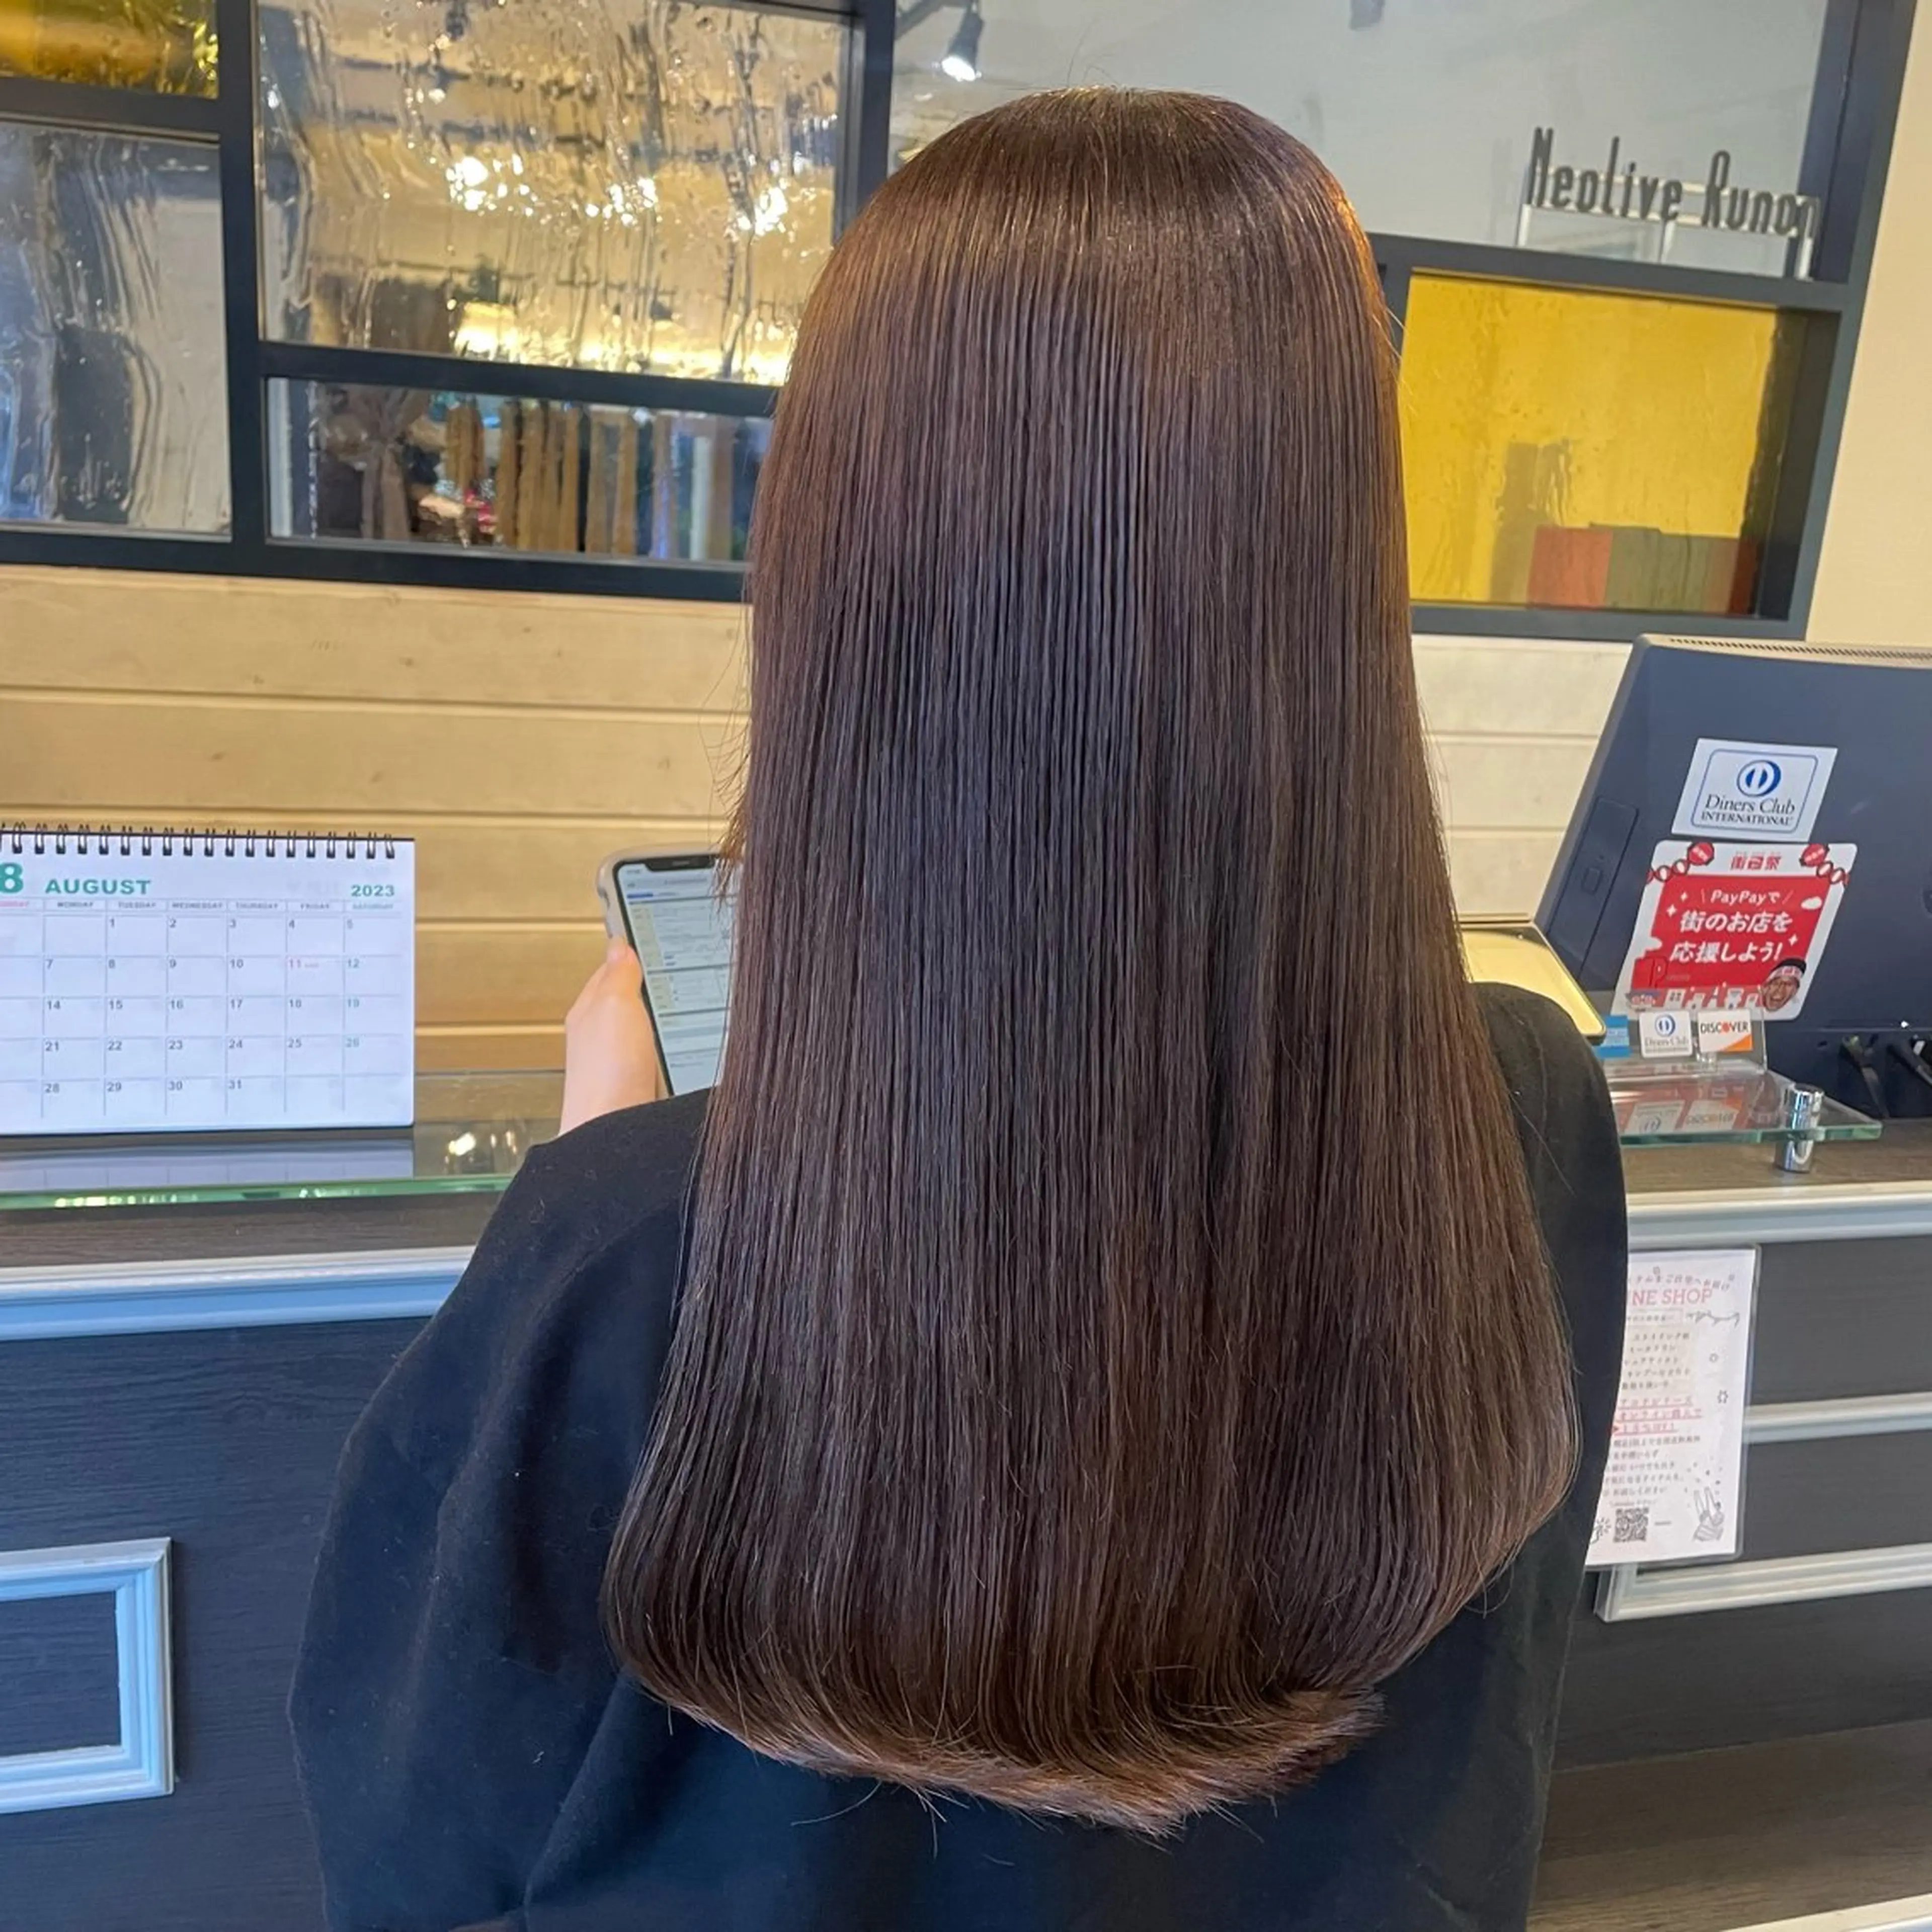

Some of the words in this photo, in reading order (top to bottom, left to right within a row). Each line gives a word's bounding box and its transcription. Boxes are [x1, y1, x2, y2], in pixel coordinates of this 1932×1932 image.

[1706, 793, 1755, 812] Diners
[1760, 797, 1795, 814] Club
[1701, 811, 1791, 825] INTERNATIONAL
[0, 862, 24, 894] 8
[45, 878, 151, 895] AUGUST
[351, 884, 395, 897] 2023
[1711, 890, 1781, 906] PayPayで
[110, 919, 115, 928] 1
[170, 919, 177, 928] 2
[229, 920, 236, 928] 3
[289, 920, 295, 928] 4
[1680, 910, 1793, 933] 街のお店を
[47, 959, 53, 969] 7
[170, 959, 177, 968] 9
[230, 959, 244, 968] 10
[289, 959, 301, 969] 11
[348, 959, 360, 968] 12
[47, 1000, 61, 1010] 14
[109, 1000, 123, 1009] 15
[171, 1000, 183, 1009] 16
[230, 1000, 243, 1008] 17
[1701, 1021, 1750, 1034] DISCOVER
[45, 1041, 59, 1052] 21
[108, 1041, 122, 1051] 22
[169, 1040, 183, 1050] 23
[229, 1039, 243, 1049] 24
[288, 1039, 301, 1048] 25
[346, 1038, 360, 1047] 26
[45, 1083, 59, 1093] 28
[107, 1082, 121, 1092] 29
[168, 1081, 183, 1091] 30
[229, 1080, 242, 1089] 31
[1661, 1285, 1713, 1305] SHOP
